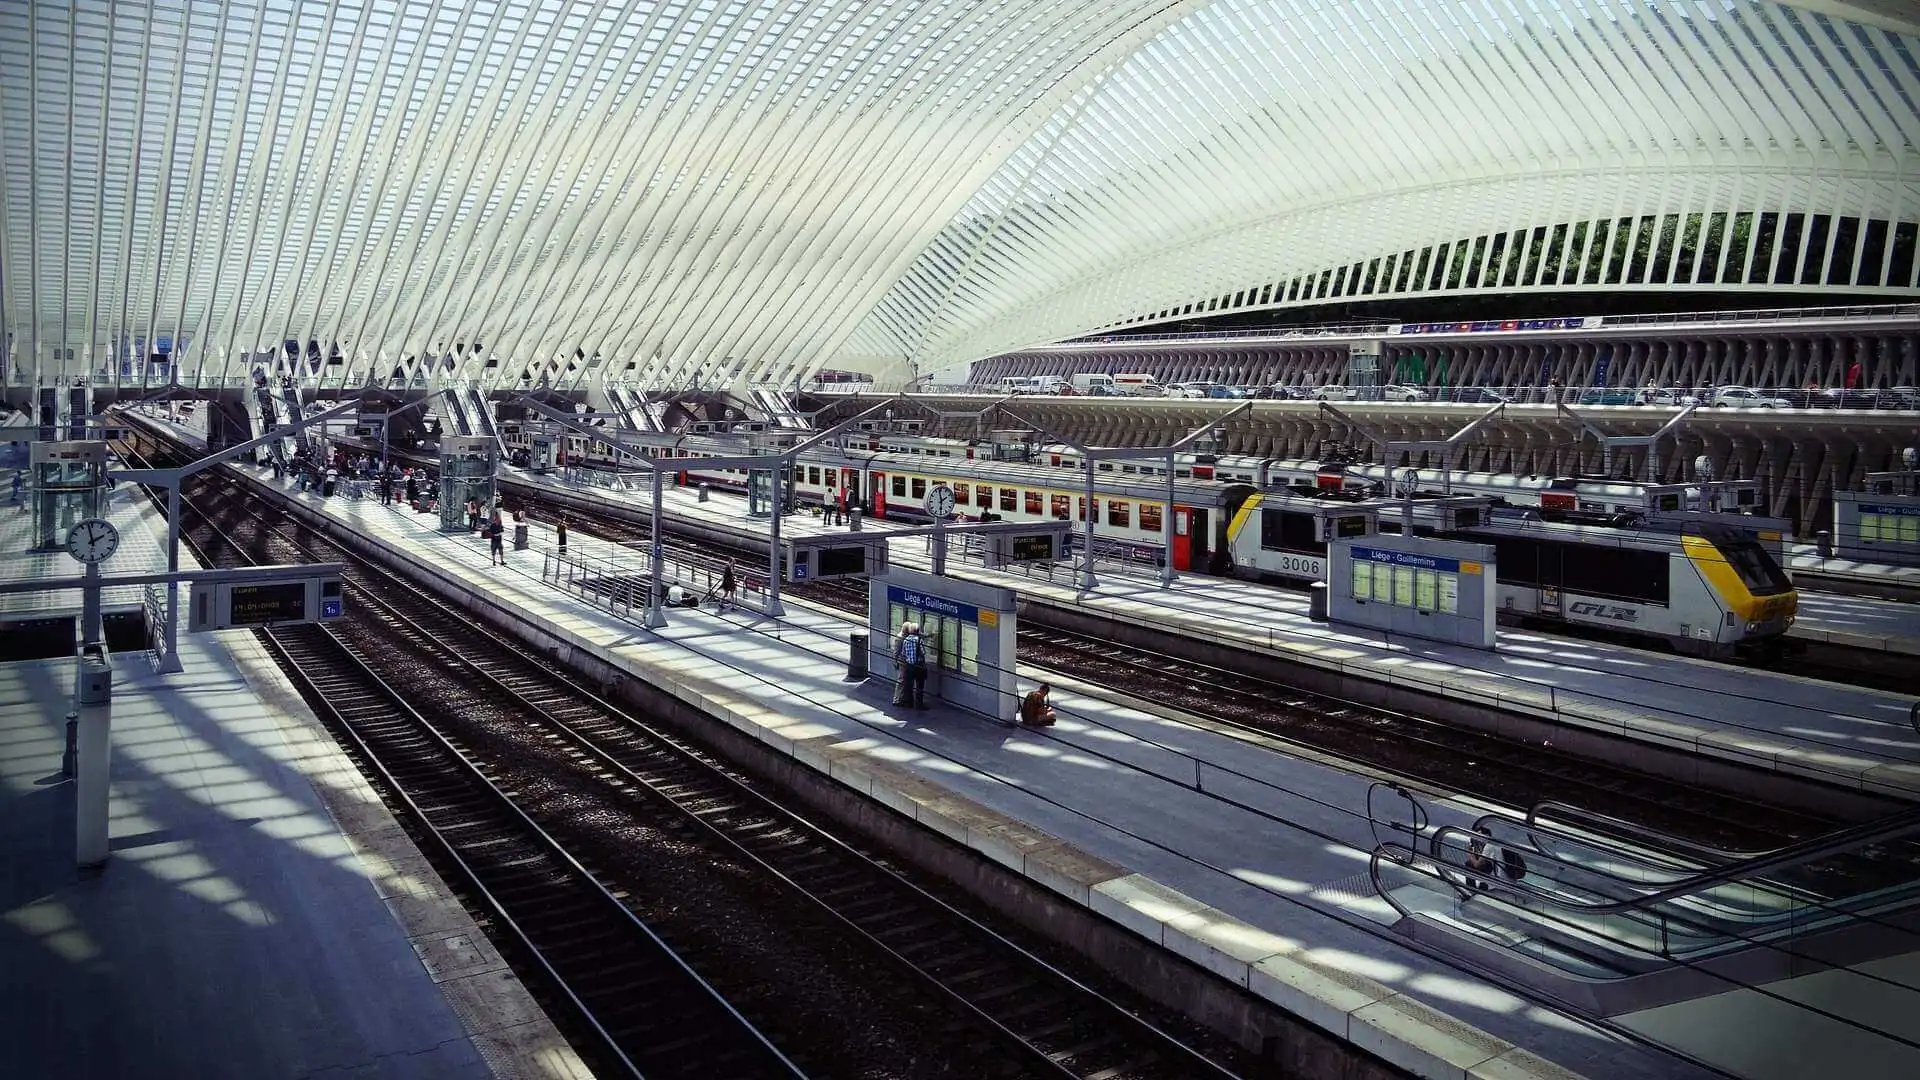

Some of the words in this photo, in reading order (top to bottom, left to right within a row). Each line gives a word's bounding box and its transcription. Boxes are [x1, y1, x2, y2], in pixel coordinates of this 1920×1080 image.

[1282, 556, 1320, 574] 3006
[1371, 551, 1391, 561] Liège
[1396, 554, 1436, 567] Guillemins
[904, 592, 920, 606] Liège
[925, 597, 958, 614] Guillemins
[1569, 601, 1612, 618] CFL
